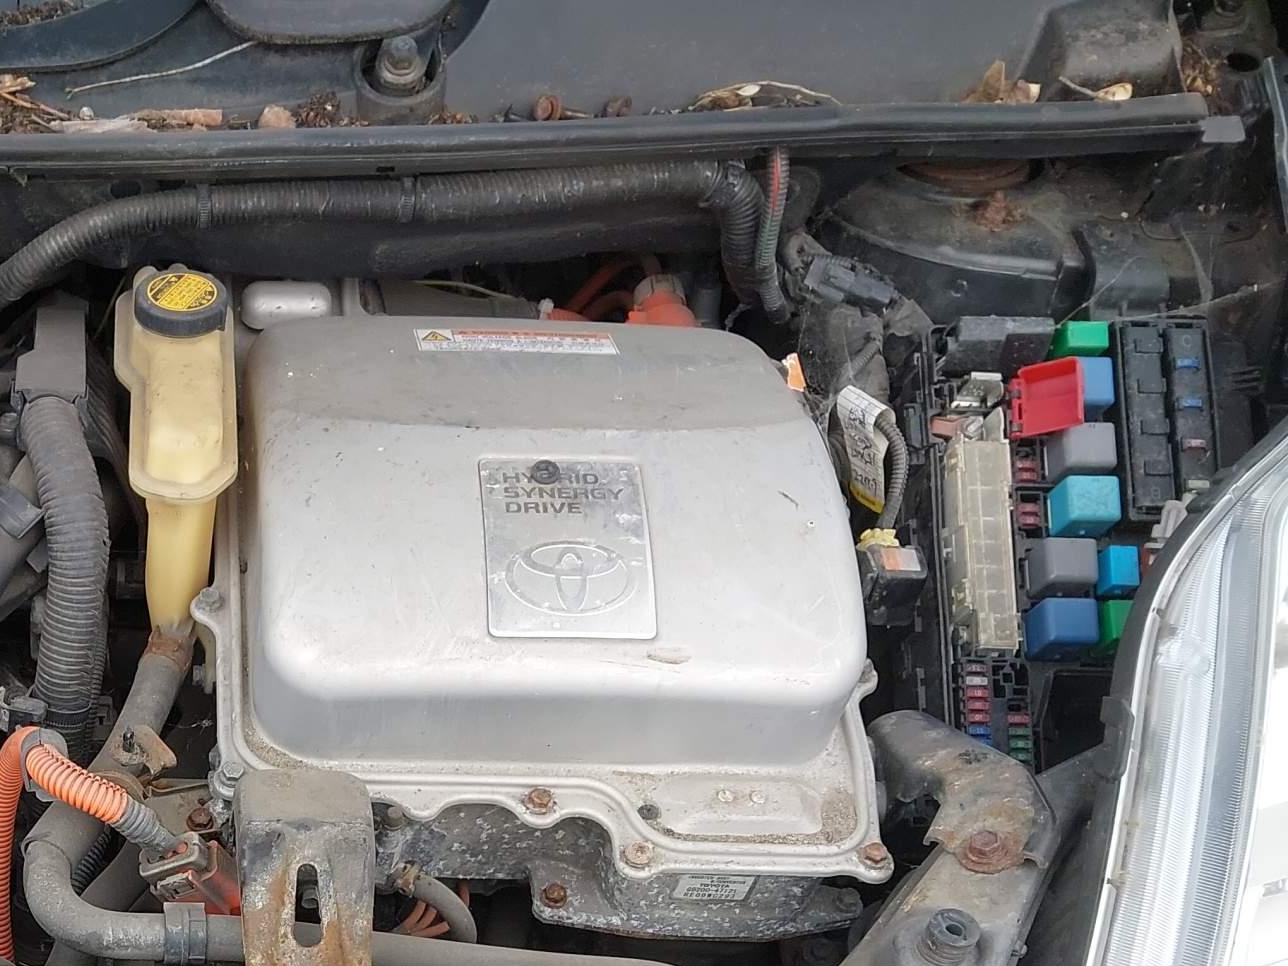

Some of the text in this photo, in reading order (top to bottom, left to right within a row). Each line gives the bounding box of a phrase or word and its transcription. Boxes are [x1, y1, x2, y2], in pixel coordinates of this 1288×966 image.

[502, 472, 600, 485] HYRID
[504, 487, 625, 501] SYNERGY
[505, 501, 584, 514] DRIVE
